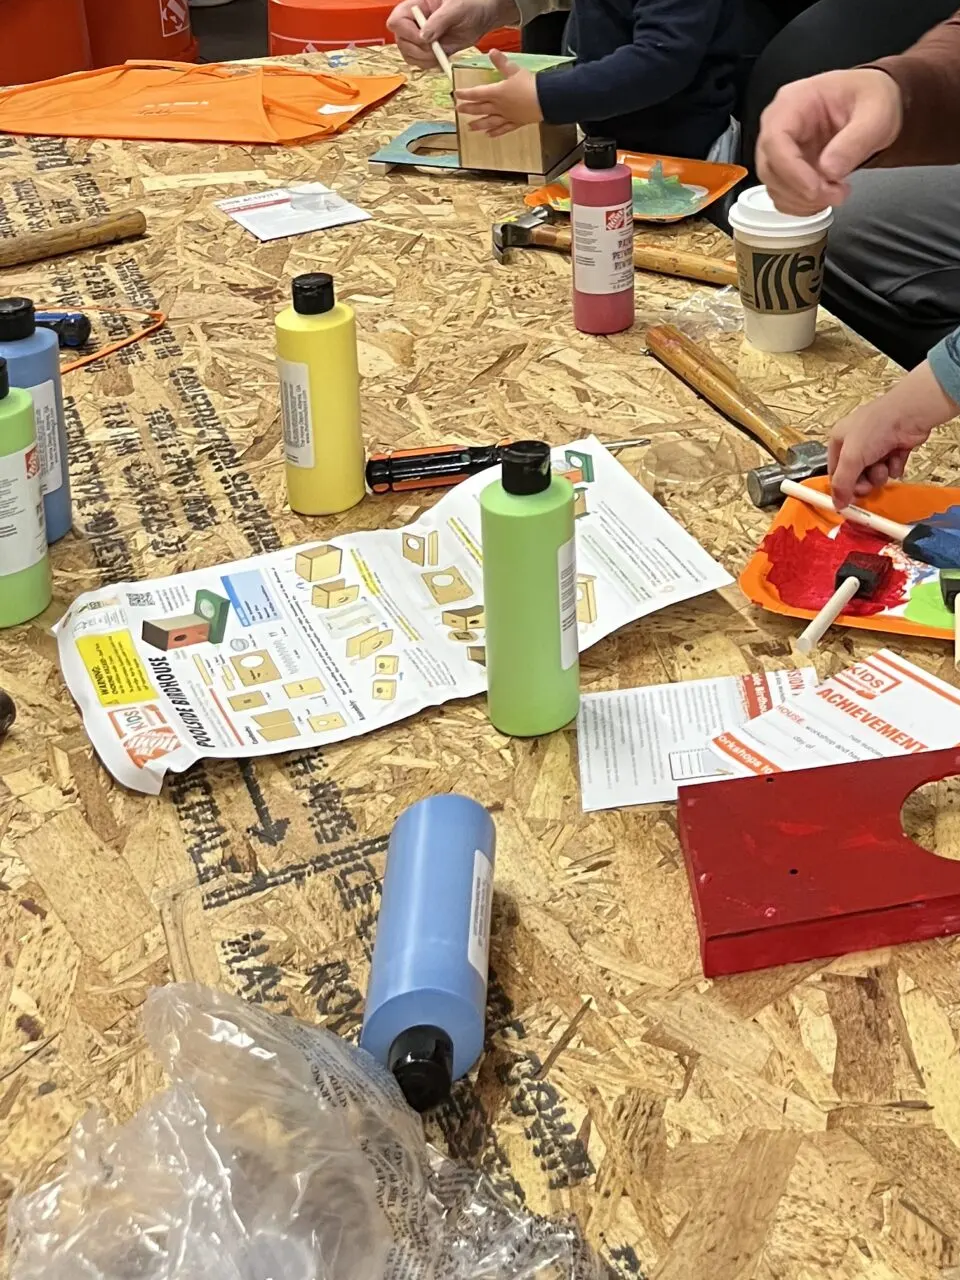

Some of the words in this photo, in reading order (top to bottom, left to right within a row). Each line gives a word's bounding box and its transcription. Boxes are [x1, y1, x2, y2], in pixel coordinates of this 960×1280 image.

[148, 656, 190, 707] BIRDHOUSE
[849, 665, 885, 689] KIDS
[176, 706, 216, 748] POOLSIDE
[815, 687, 930, 754] ACHIEVEMENT
